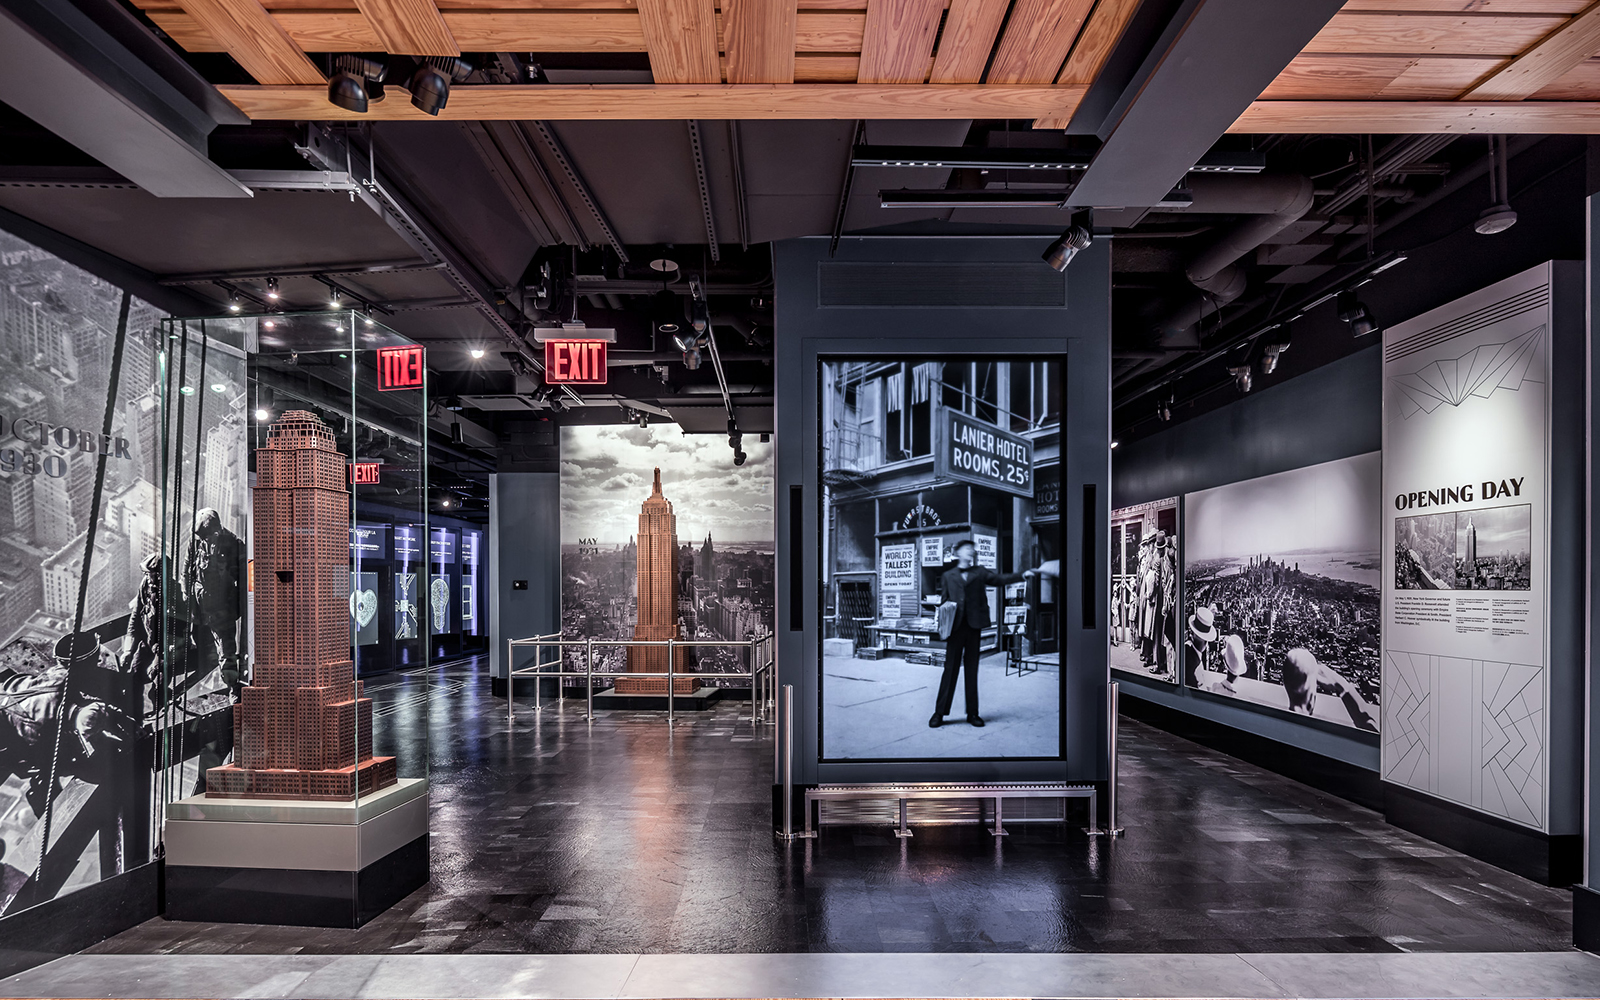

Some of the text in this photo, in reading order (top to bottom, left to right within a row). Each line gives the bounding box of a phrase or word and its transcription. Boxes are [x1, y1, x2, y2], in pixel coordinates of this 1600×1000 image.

[554, 343, 601, 380] EXIT
[953, 421, 1029, 465] LANIER HOTEL
[953, 447, 1004, 481] ROOMS,
[355, 465, 376, 482] EXIT
[1394, 477, 1525, 510] OPENING DAY
[1037, 503, 1058, 514] ROOMS
[578, 537, 598, 545] MAY
[579, 547, 598, 555] 1931
[885, 551, 913, 560] WORLD'S
[885, 560, 912, 569] TALLEST
[884, 570, 912, 579] BUILDING
